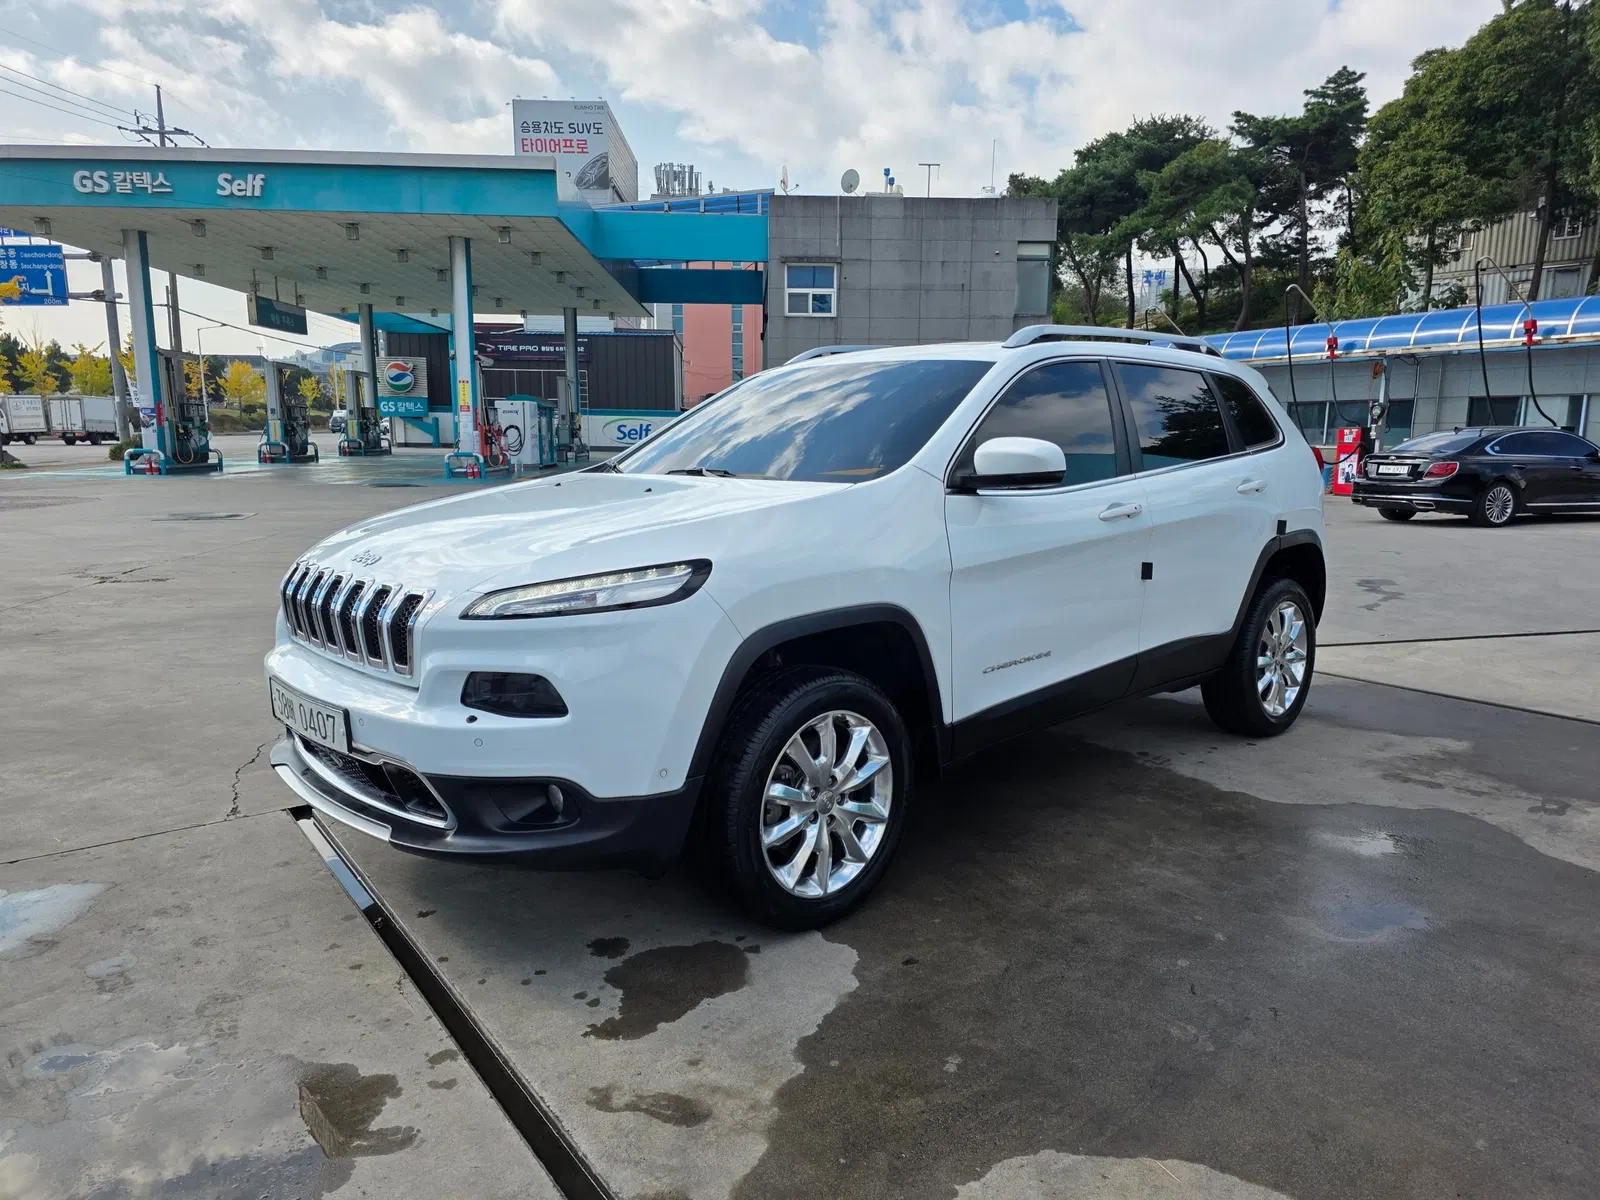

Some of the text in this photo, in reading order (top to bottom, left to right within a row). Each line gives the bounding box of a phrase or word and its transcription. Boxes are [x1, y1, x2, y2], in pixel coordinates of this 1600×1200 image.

[520, 120, 604, 135] 승용차도 SUV도
[521, 138, 589, 154] 타이어프로
[73, 170, 173, 194] GS 칼텍스
[216, 173, 265, 197] Self
[380, 401, 423, 412] GS 칼텍스
[616, 423, 652, 441] Self
[351, 549, 382, 567] Jeep
[982, 650, 1052, 674] CHEROKEE
[299, 702, 336, 744] 0407
